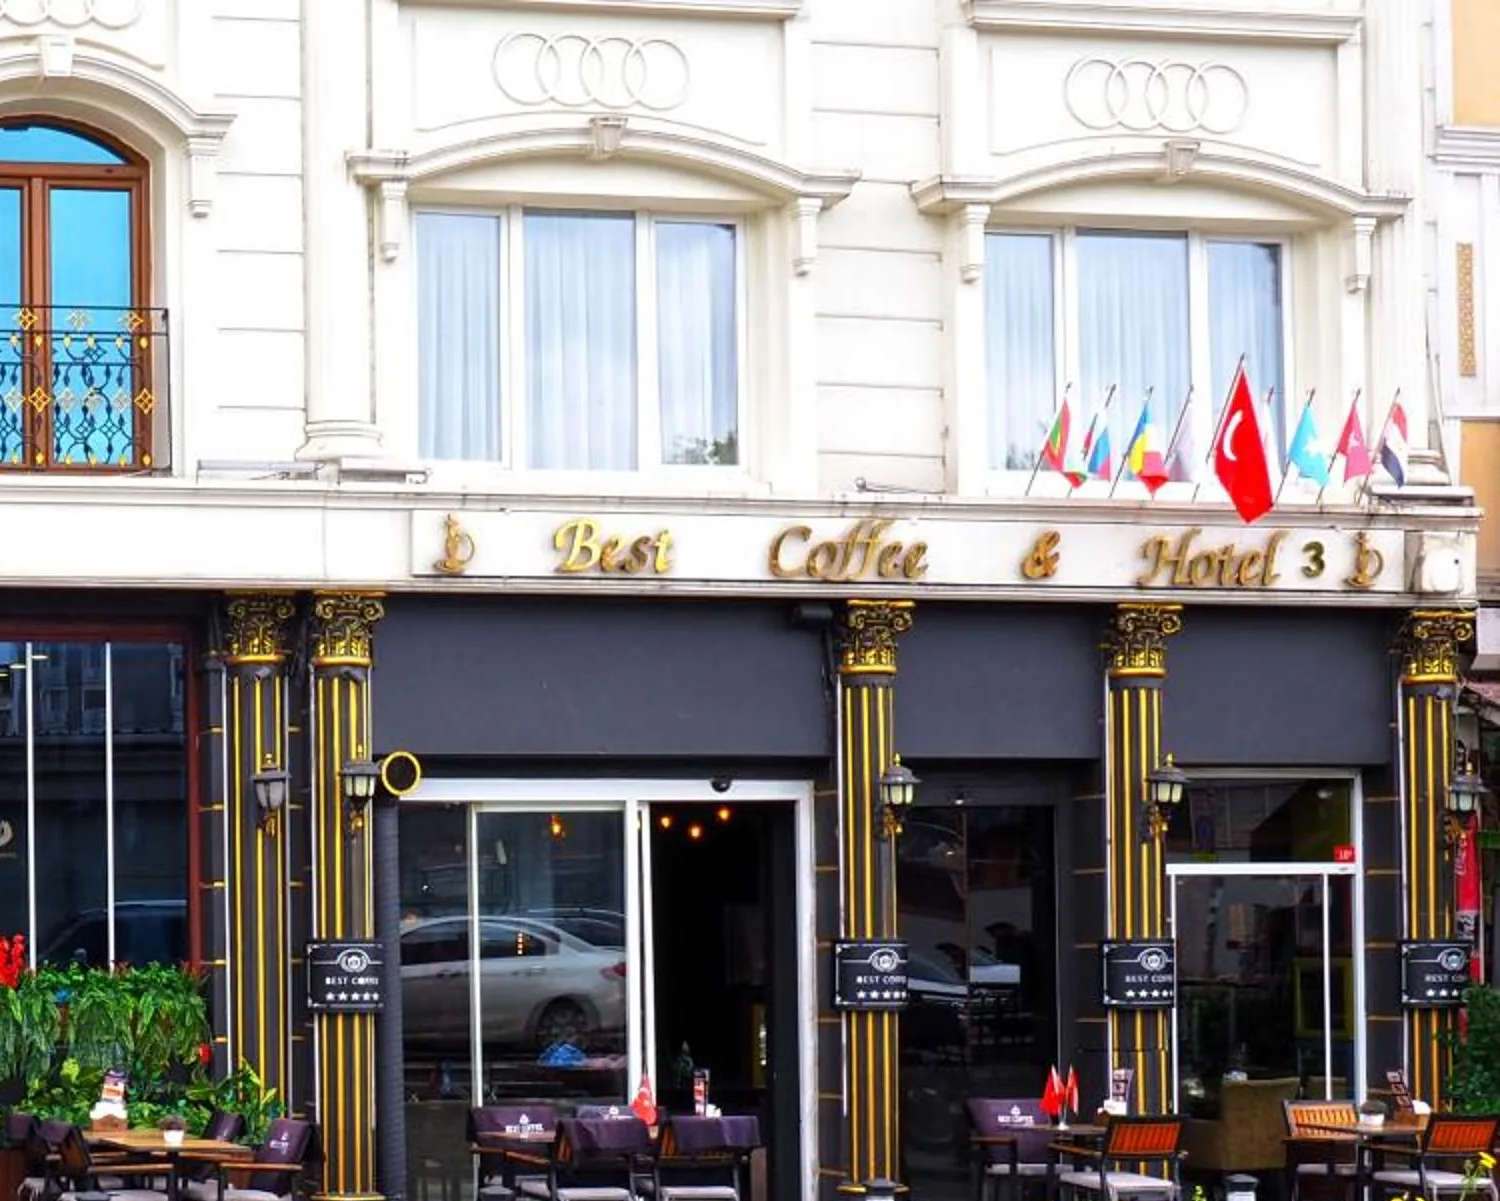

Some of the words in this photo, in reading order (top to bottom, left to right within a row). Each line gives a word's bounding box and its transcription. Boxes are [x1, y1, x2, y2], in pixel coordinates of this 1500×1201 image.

[553, 516, 674, 576] Best
[768, 518, 930, 582] Coffee
[1137, 527, 1291, 588] Hotel
[1302, 541, 1326, 578] 3
